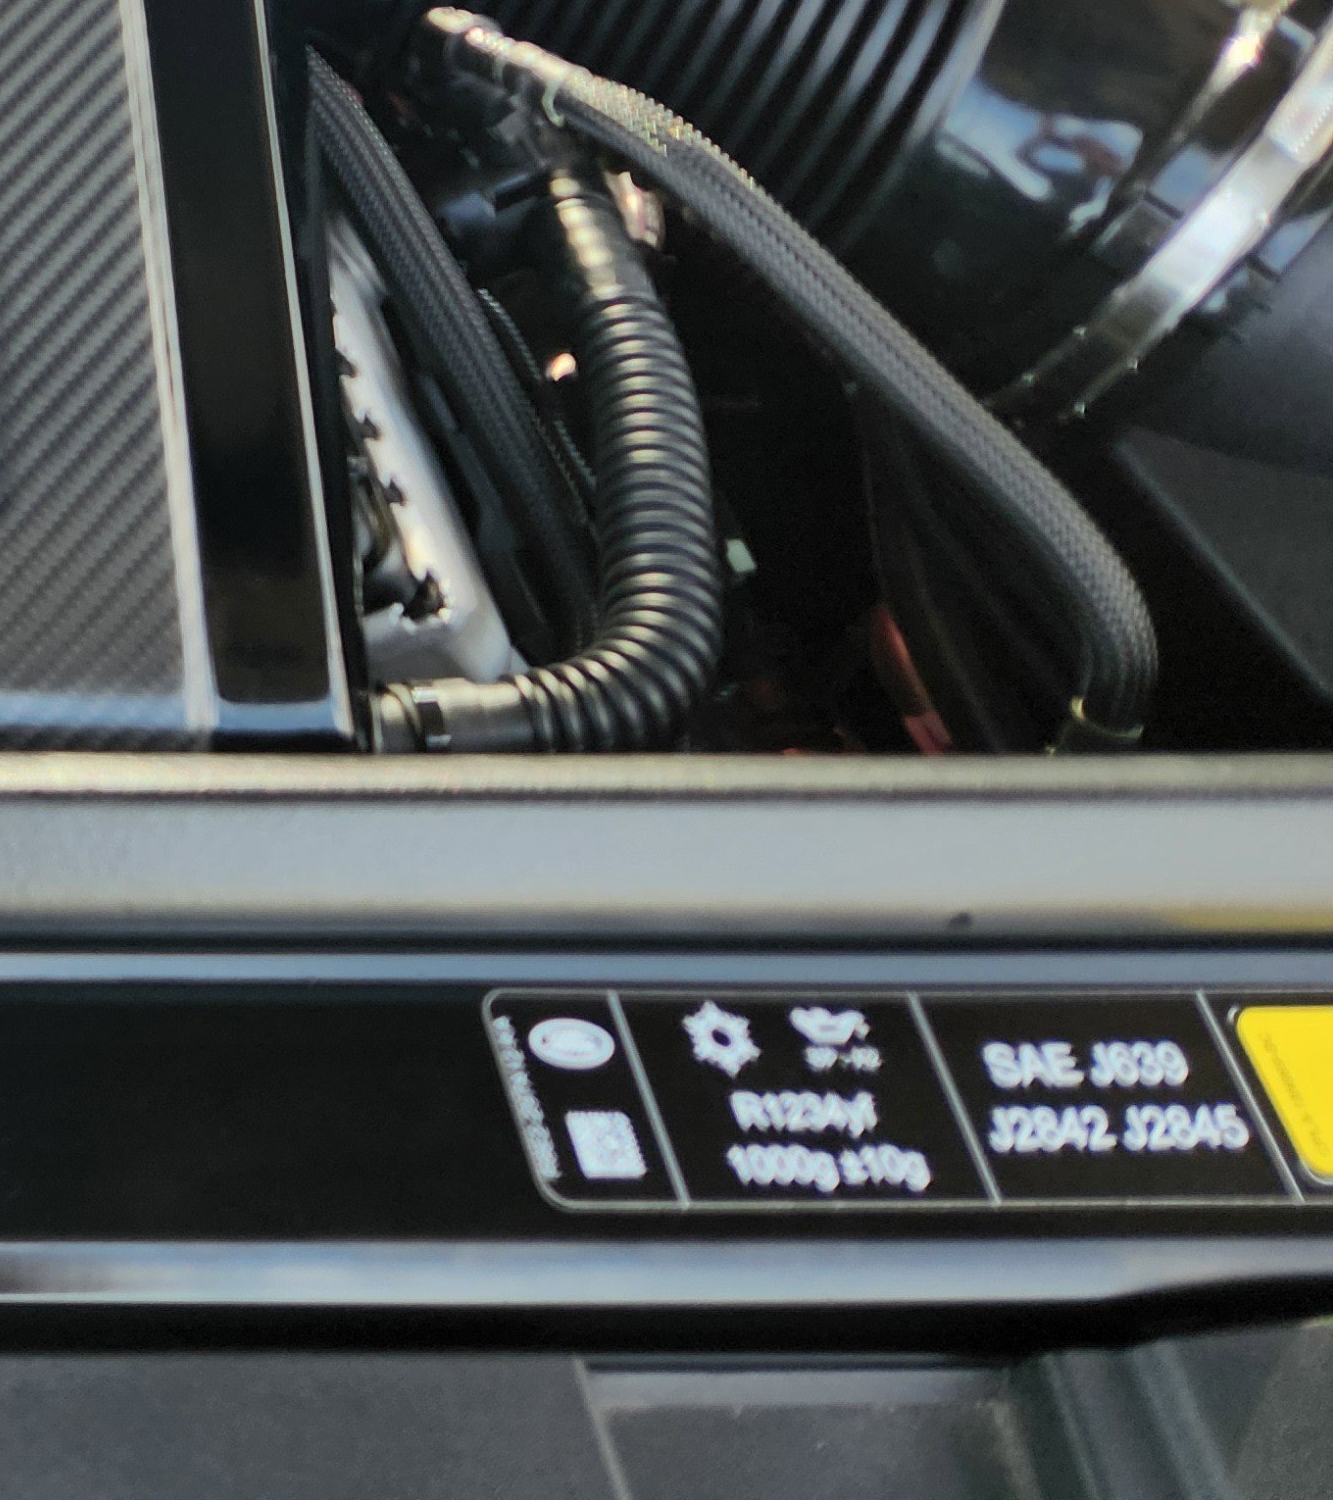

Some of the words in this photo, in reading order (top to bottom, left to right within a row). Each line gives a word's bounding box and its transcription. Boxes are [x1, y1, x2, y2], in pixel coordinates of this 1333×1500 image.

[982, 1041, 1084, 1089] SAE
[1088, 1040, 1189, 1087] J639
[988, 1105, 1118, 1153] J2842
[1122, 1104, 1250, 1152] J2845
